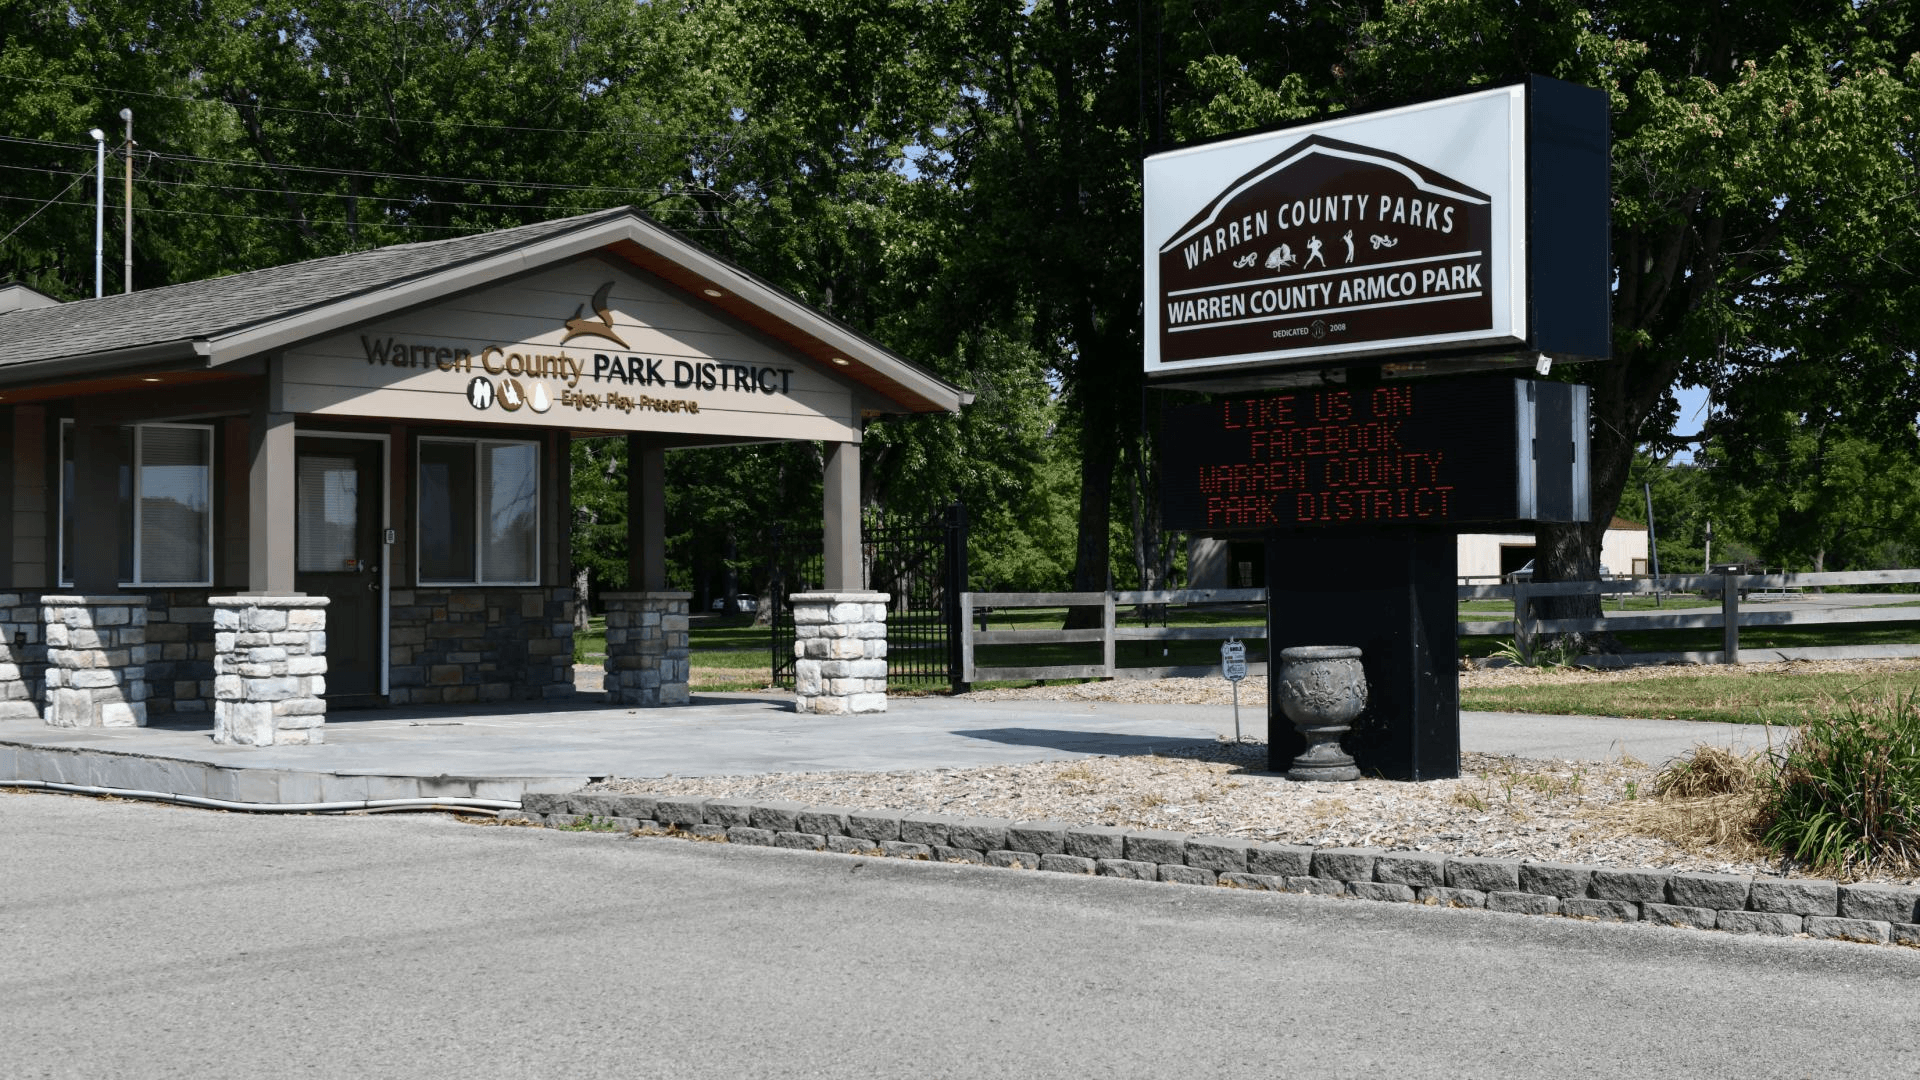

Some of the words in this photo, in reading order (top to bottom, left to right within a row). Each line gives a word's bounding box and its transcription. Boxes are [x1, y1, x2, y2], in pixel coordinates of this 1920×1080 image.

[1184, 210, 1267, 270] WARREN
[1278, 194, 1369, 229] COUNTY
[1379, 195, 1454, 233] PARKS
[1168, 293, 1245, 324] WARREN
[1250, 283, 1333, 315] COUNTY
[1338, 272, 1417, 303] ARMCO
[1422, 263, 1482, 294] PARK
[1329, 323, 1346, 332] 2008
[361, 335, 471, 372] Warren
[482, 345, 584, 386] County
[594, 353, 665, 386] PARK
[674, 360, 794, 395] DISTRICT
[1224, 395, 1295, 428] LIKE
[1315, 392, 1351, 421] US
[1373, 386, 1412, 417] ON
[1252, 420, 1401, 458] FACEBOOK
[1200, 460, 1305, 493] WARREN
[1326, 451, 1443, 487] COUNTY
[1208, 494, 1278, 527] PARK
[1297, 485, 1454, 521] DISTRICT
